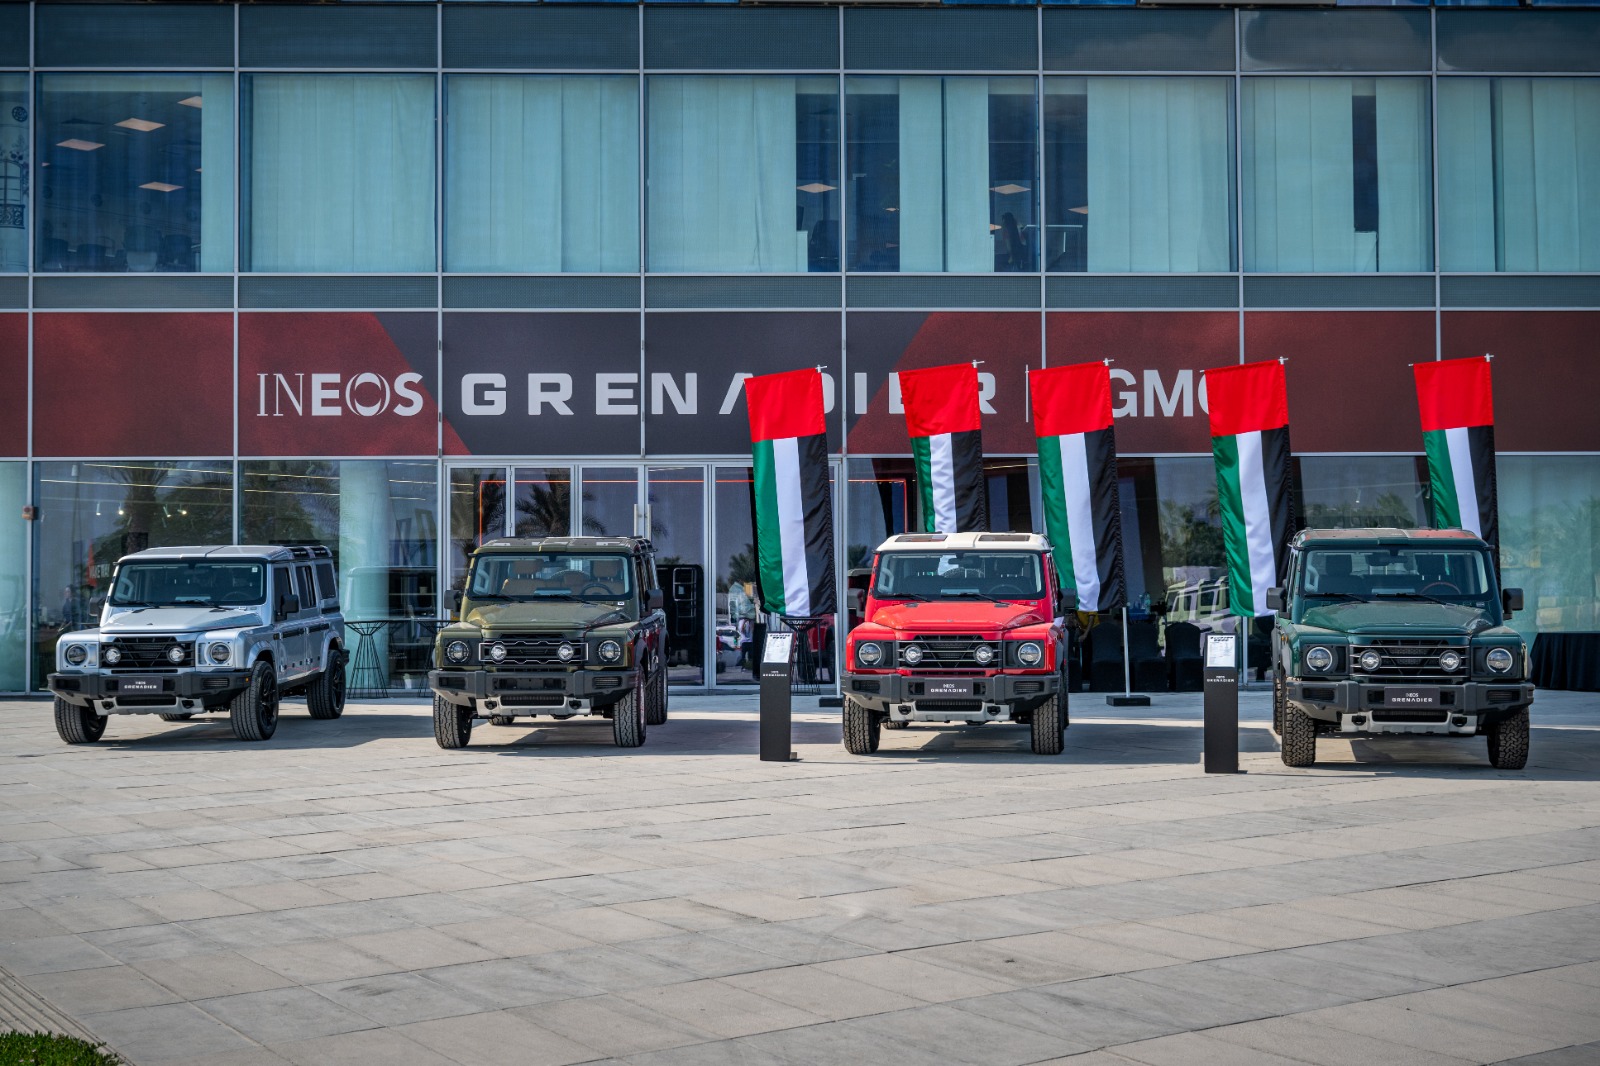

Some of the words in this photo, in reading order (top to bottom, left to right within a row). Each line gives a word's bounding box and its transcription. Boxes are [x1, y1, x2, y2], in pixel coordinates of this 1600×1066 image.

[256, 372, 424, 417] INEOS
[461, 372, 998, 415] GRENAI
[1109, 368, 1209, 418] GM
